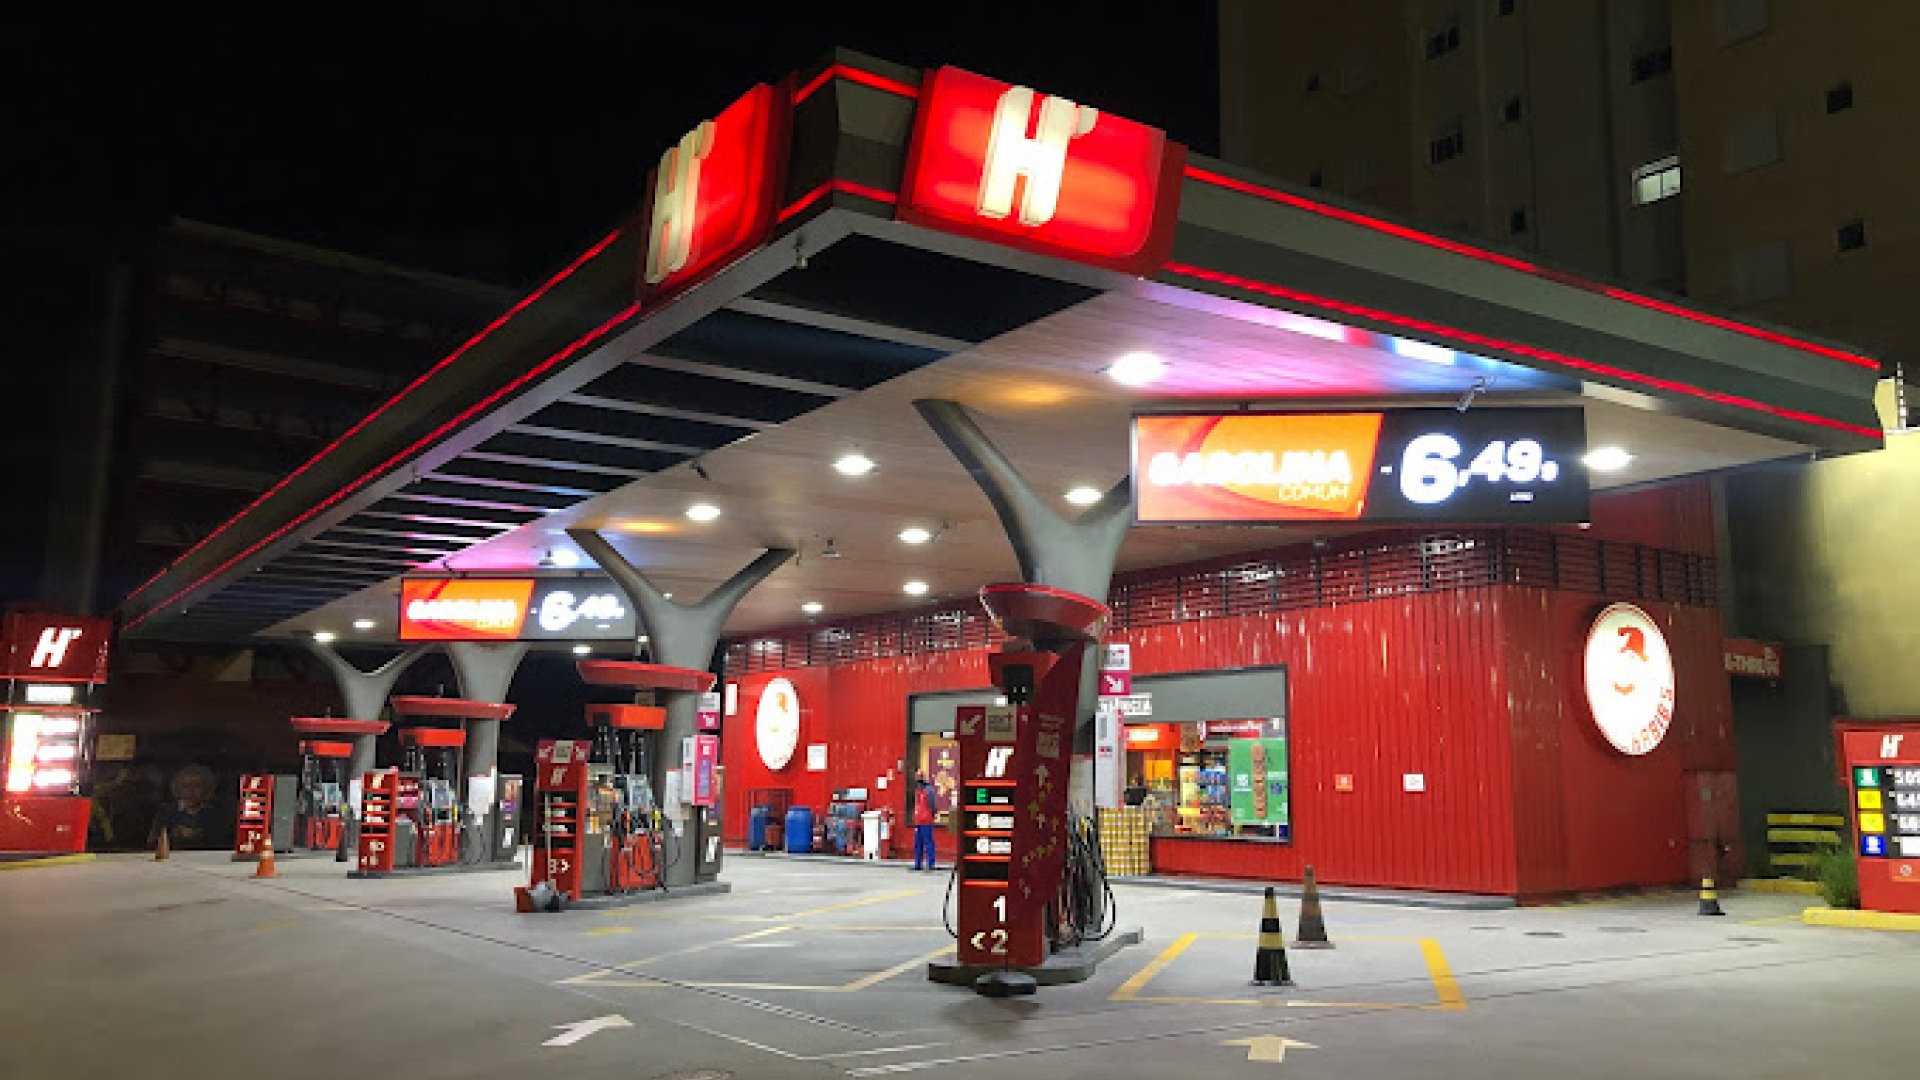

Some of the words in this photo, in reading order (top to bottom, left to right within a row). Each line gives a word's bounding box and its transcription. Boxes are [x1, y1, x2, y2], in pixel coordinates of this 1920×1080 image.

[1279, 485, 1349, 500] COMUM
[30, 627, 83, 668] H
[1880, 734, 1904, 758] H
[984, 746, 1014, 778] H
[976, 788, 988, 803] E
[993, 895, 1006, 922] 1
[990, 929, 1009, 953] 2
